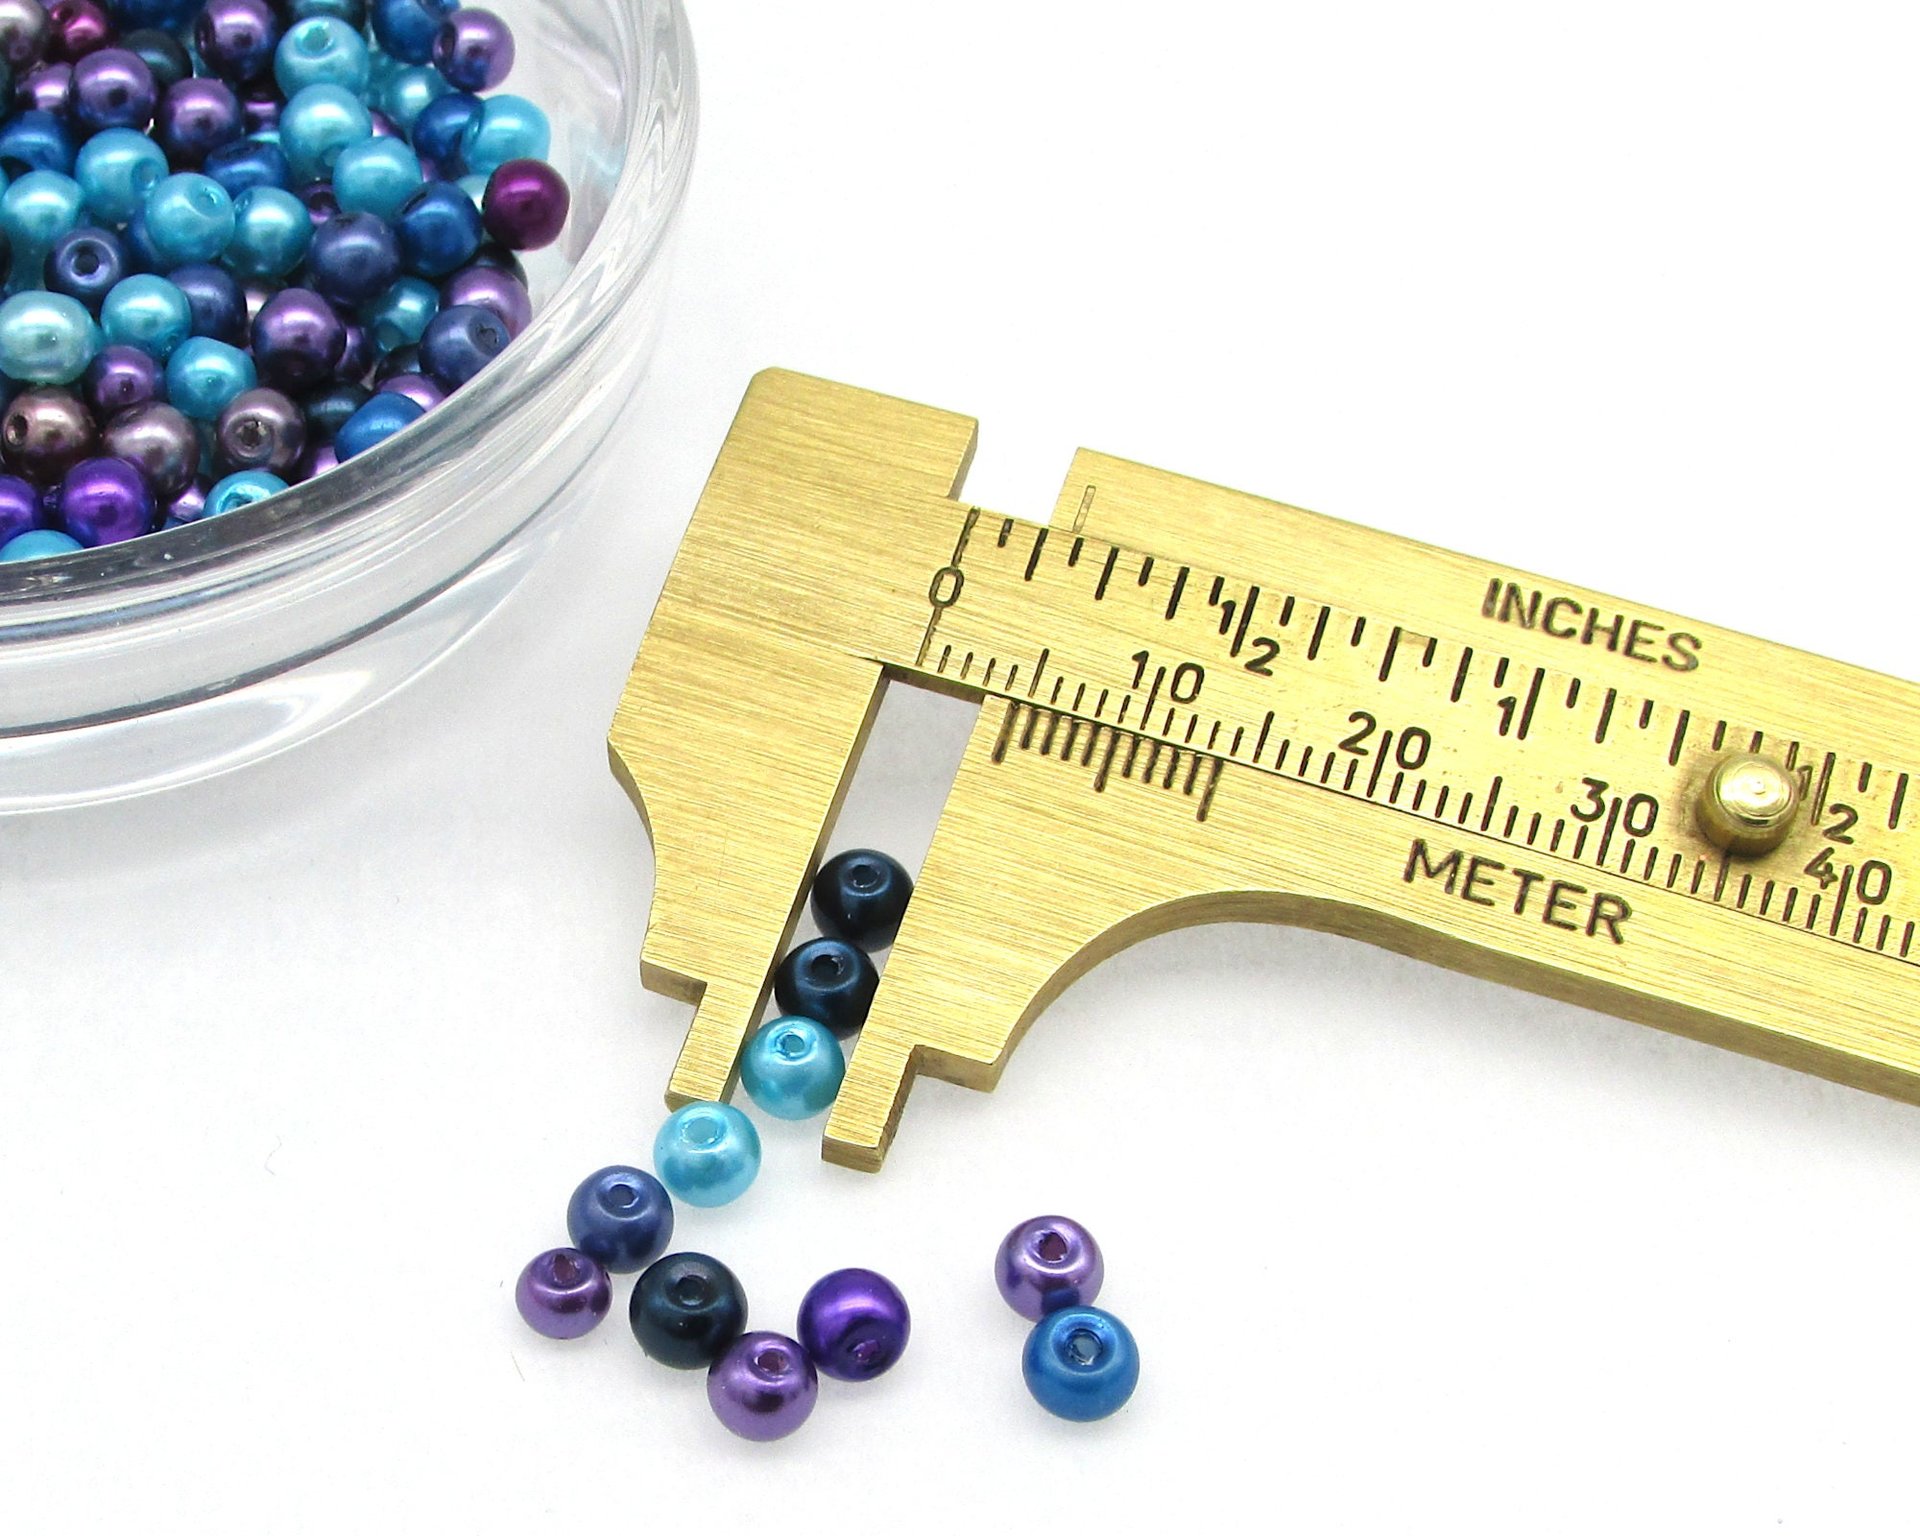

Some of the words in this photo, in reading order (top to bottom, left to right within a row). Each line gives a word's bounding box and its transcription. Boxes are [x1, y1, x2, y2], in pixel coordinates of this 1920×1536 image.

[929, 566, 964, 608] 0
[1482, 578, 1704, 673] INCHES
[1338, 711, 1432, 771] 20
[1570, 776, 1660, 838] 30
[1402, 838, 1633, 945] METER
